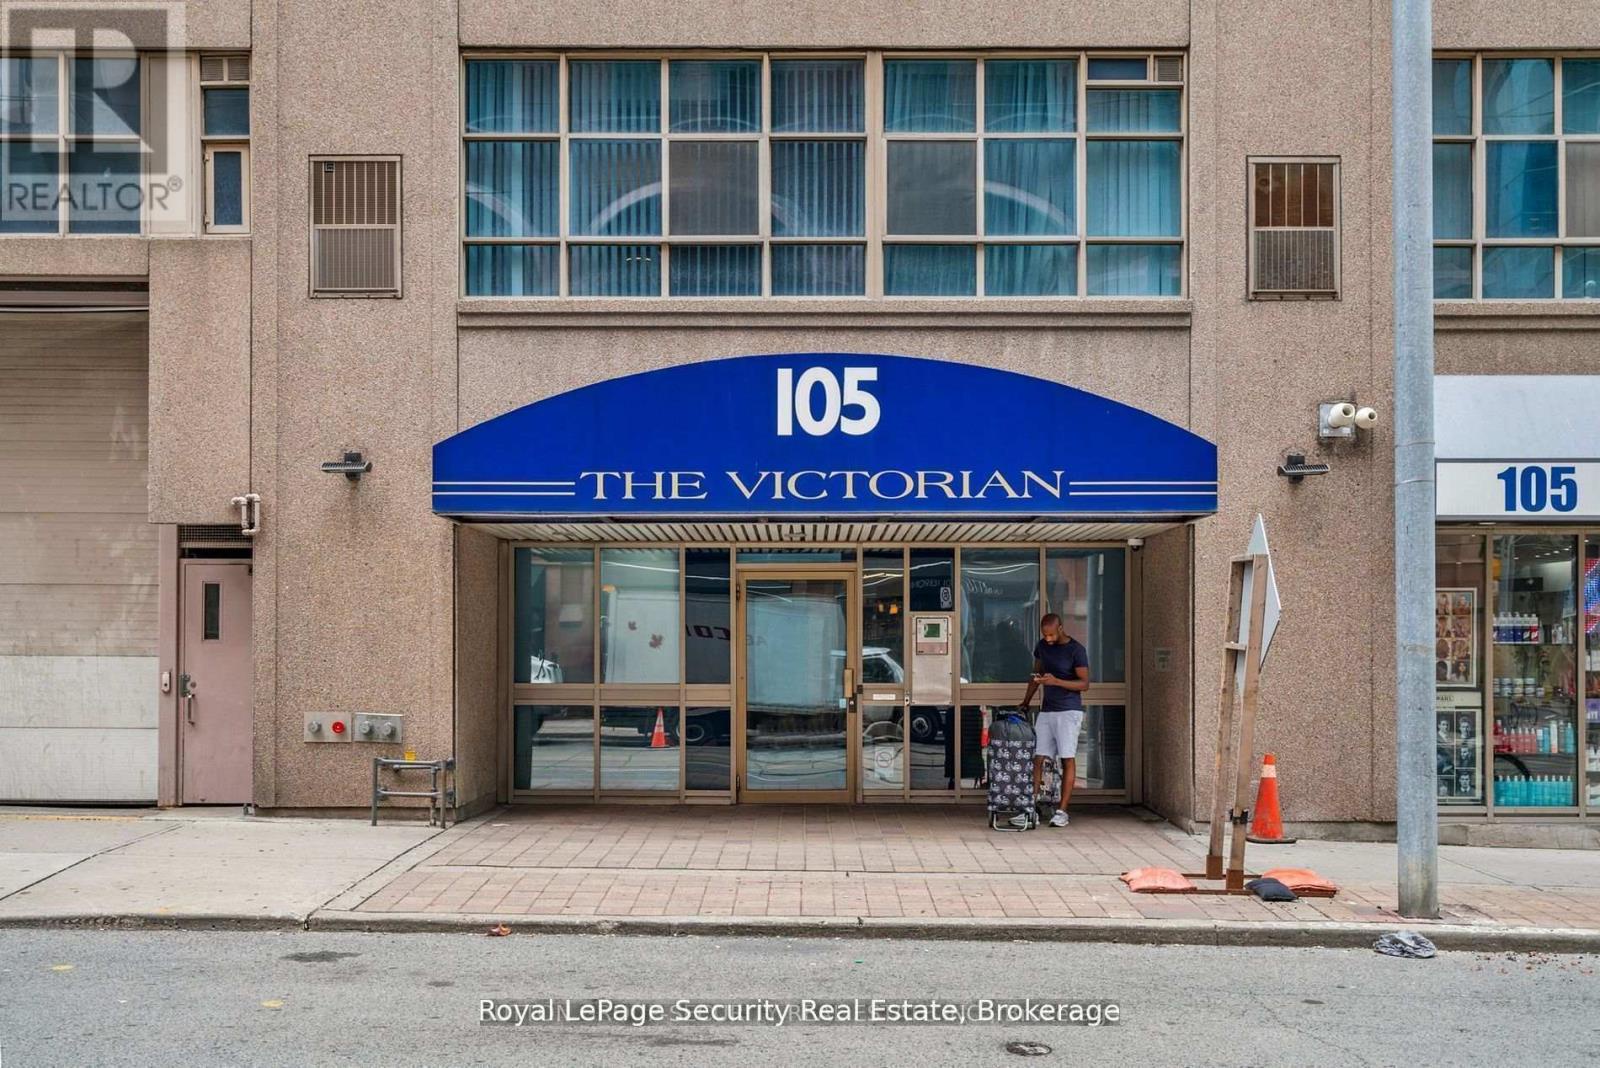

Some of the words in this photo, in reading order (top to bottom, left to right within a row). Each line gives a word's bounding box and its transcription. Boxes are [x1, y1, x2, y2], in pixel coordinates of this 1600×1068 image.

[777, 367, 881, 436] 105
[579, 471, 708, 500] THE
[726, 470, 1065, 500] VICTORIAN
[1497, 465, 1578, 512] 105
